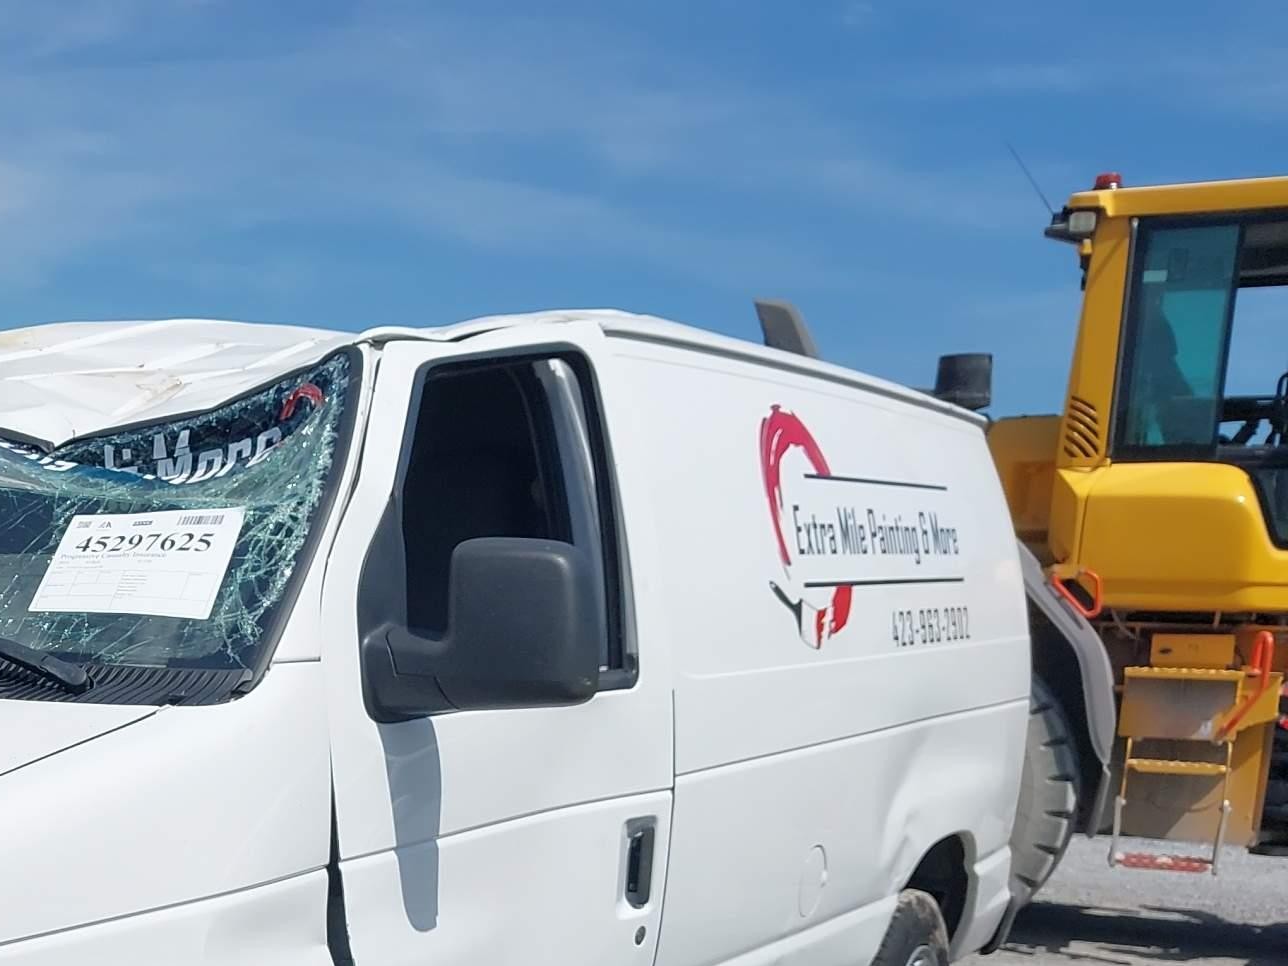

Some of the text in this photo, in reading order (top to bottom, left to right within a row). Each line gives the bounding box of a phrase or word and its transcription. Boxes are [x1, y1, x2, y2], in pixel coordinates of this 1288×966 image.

[75, 532, 215, 553] 45297625
[793, 505, 959, 564] Extra Mile Painting & More
[892, 607, 970, 646] 423-963-2902
